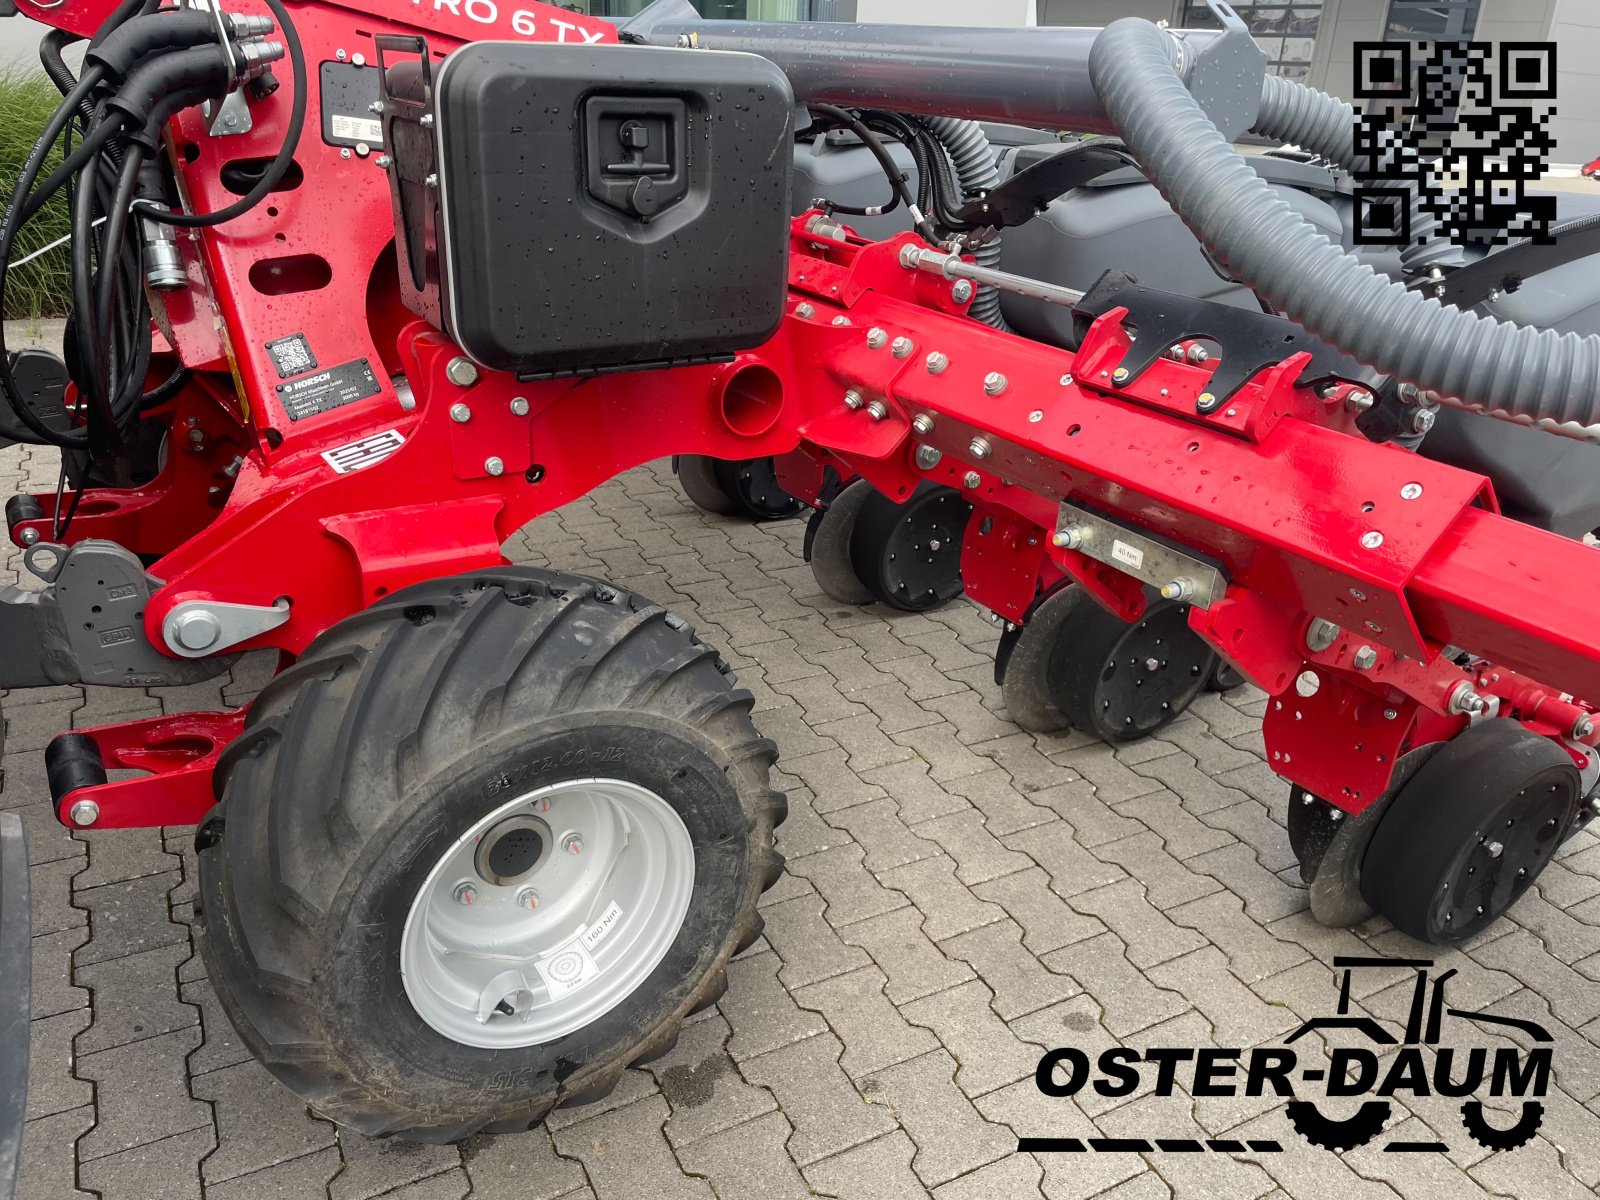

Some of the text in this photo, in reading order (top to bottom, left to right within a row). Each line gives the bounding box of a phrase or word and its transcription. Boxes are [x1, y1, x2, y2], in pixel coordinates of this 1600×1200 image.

[512, 10, 536, 36] 6
[550, 19, 604, 44] TX
[294, 372, 331, 390] HORSCH
[290, 391, 308, 400] HORSCH
[1118, 547, 1137, 561] 40 Nm
[587, 909, 617, 942] 160 Nm
